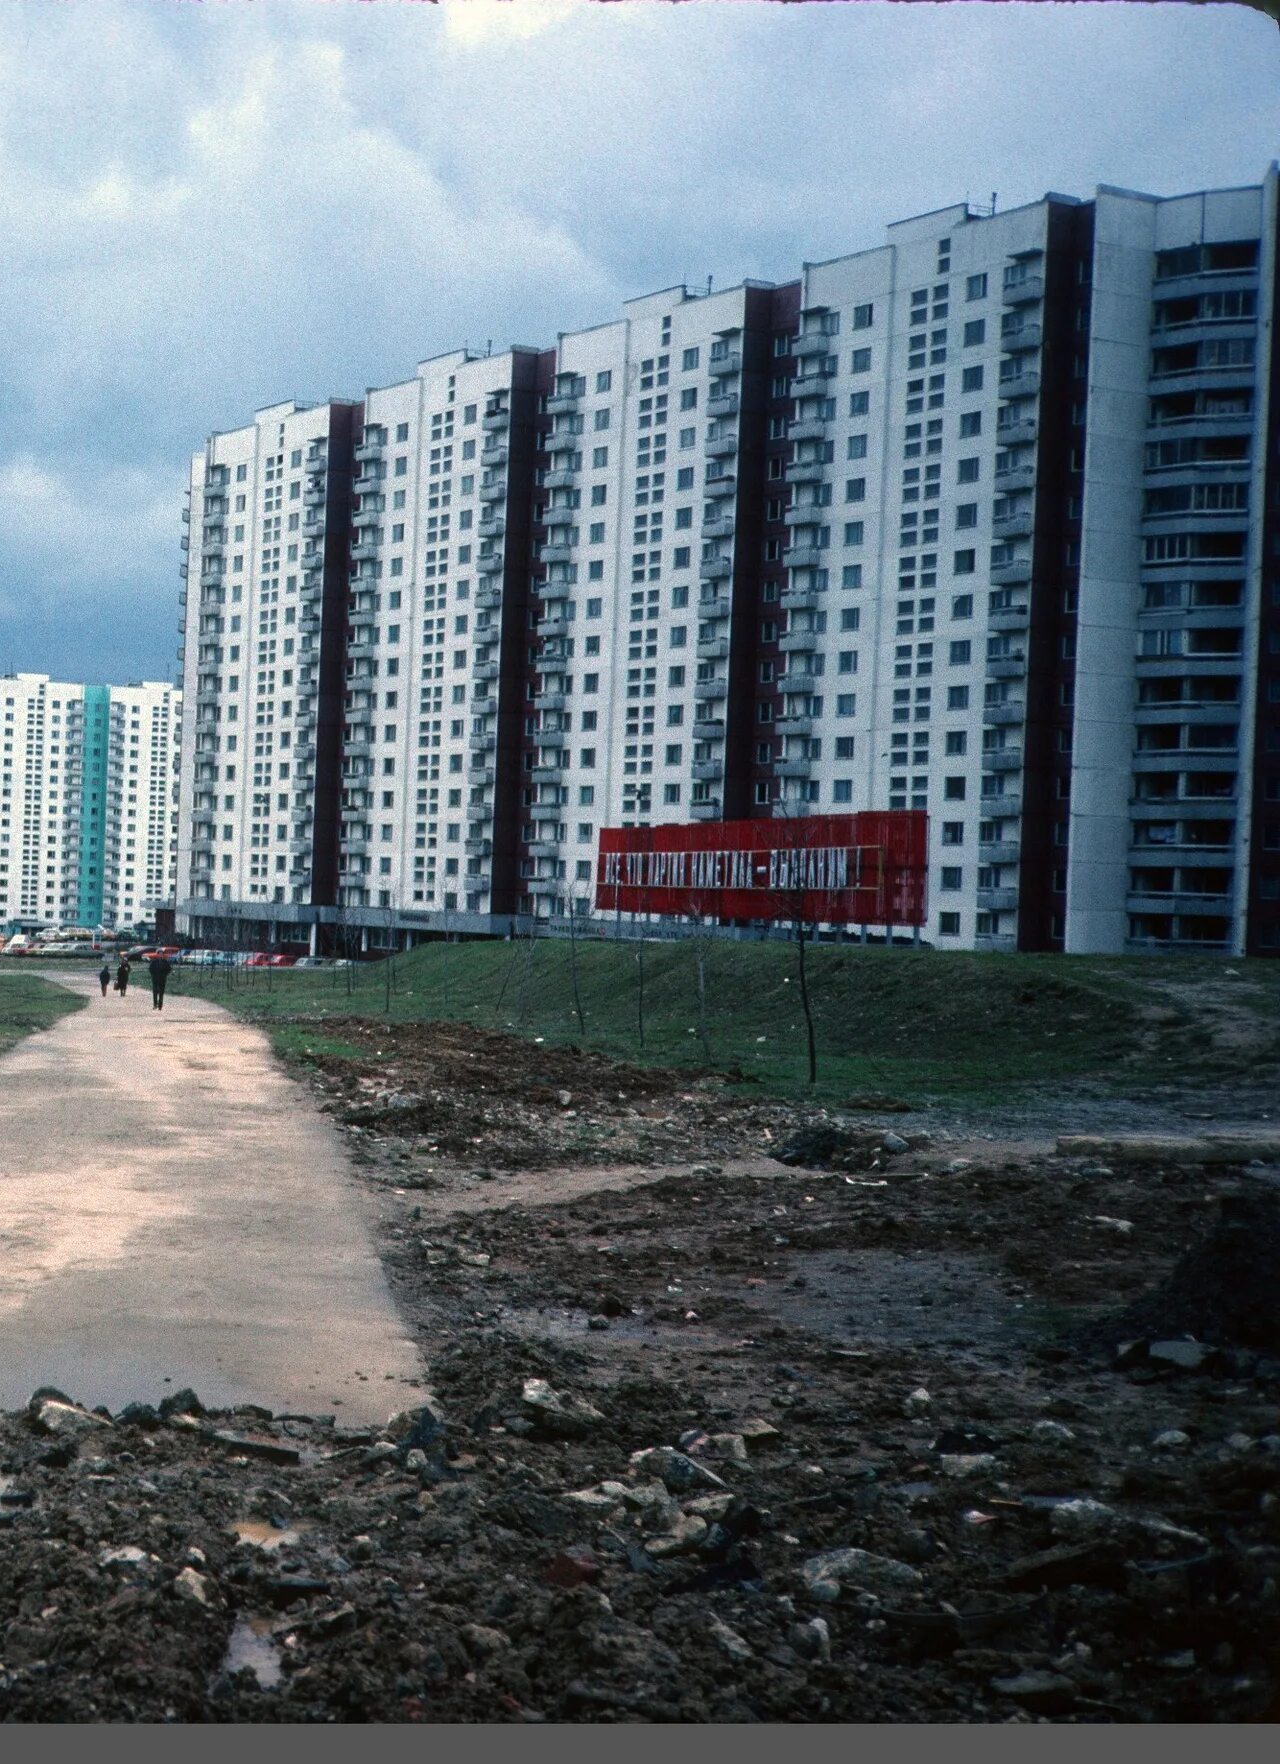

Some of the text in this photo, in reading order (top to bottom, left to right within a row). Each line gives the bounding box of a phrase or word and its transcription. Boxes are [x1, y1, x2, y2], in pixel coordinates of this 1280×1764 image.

[626, 852, 642, 886] ЧТО
[647, 851, 685, 887] ПАРТИЯ
[691, 850, 753, 888] НАМЕТИЛА
